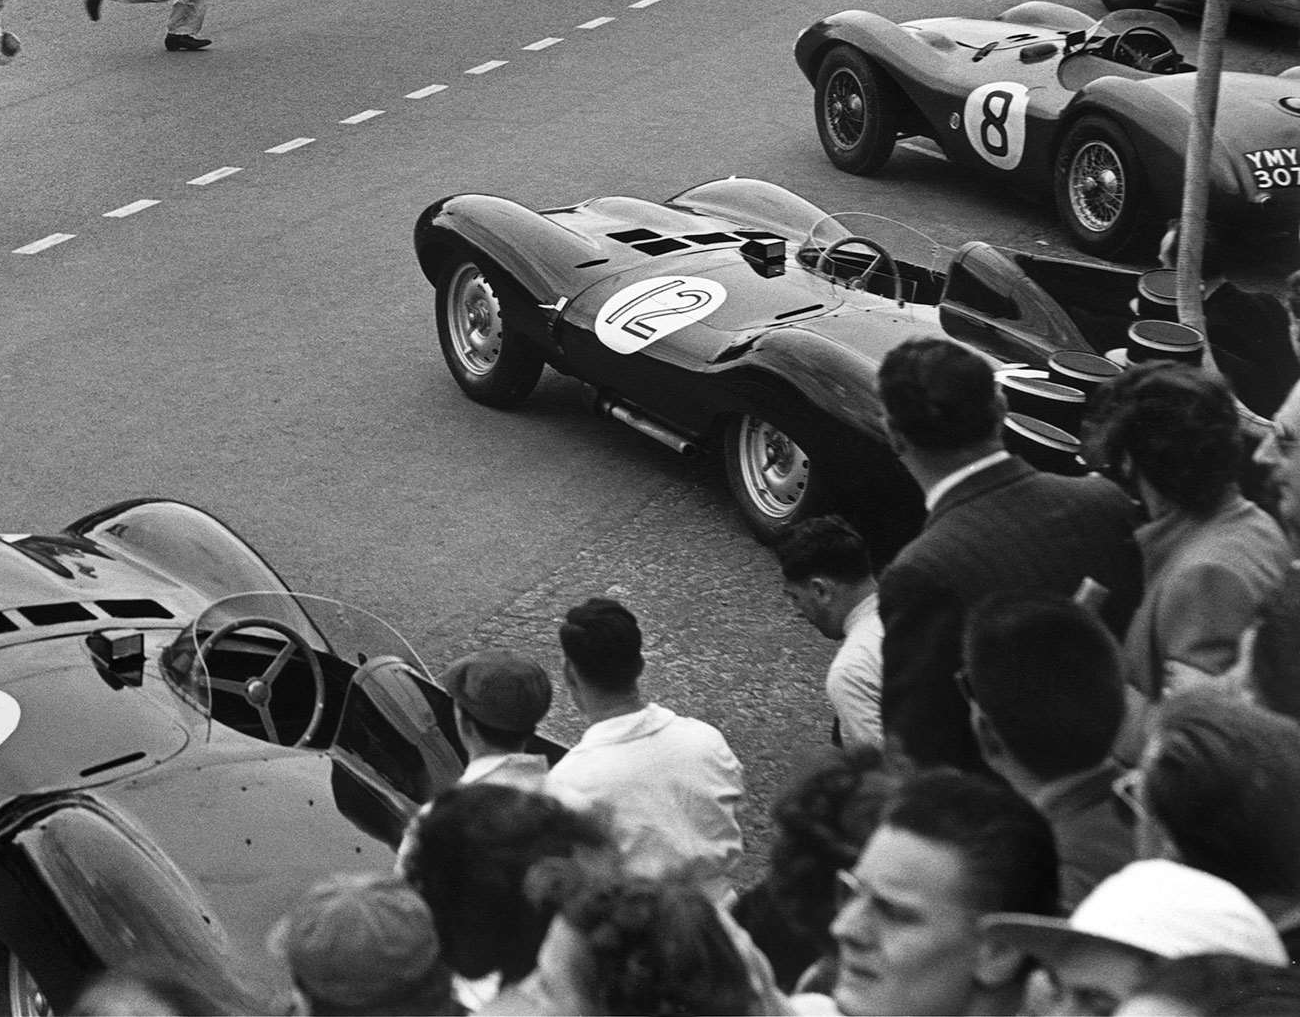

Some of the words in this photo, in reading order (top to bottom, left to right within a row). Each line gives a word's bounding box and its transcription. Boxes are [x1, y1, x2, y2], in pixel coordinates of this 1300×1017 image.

[980, 90, 1013, 158] 8
[1245, 148, 1297, 169] YMY
[605, 280, 712, 340] 12
